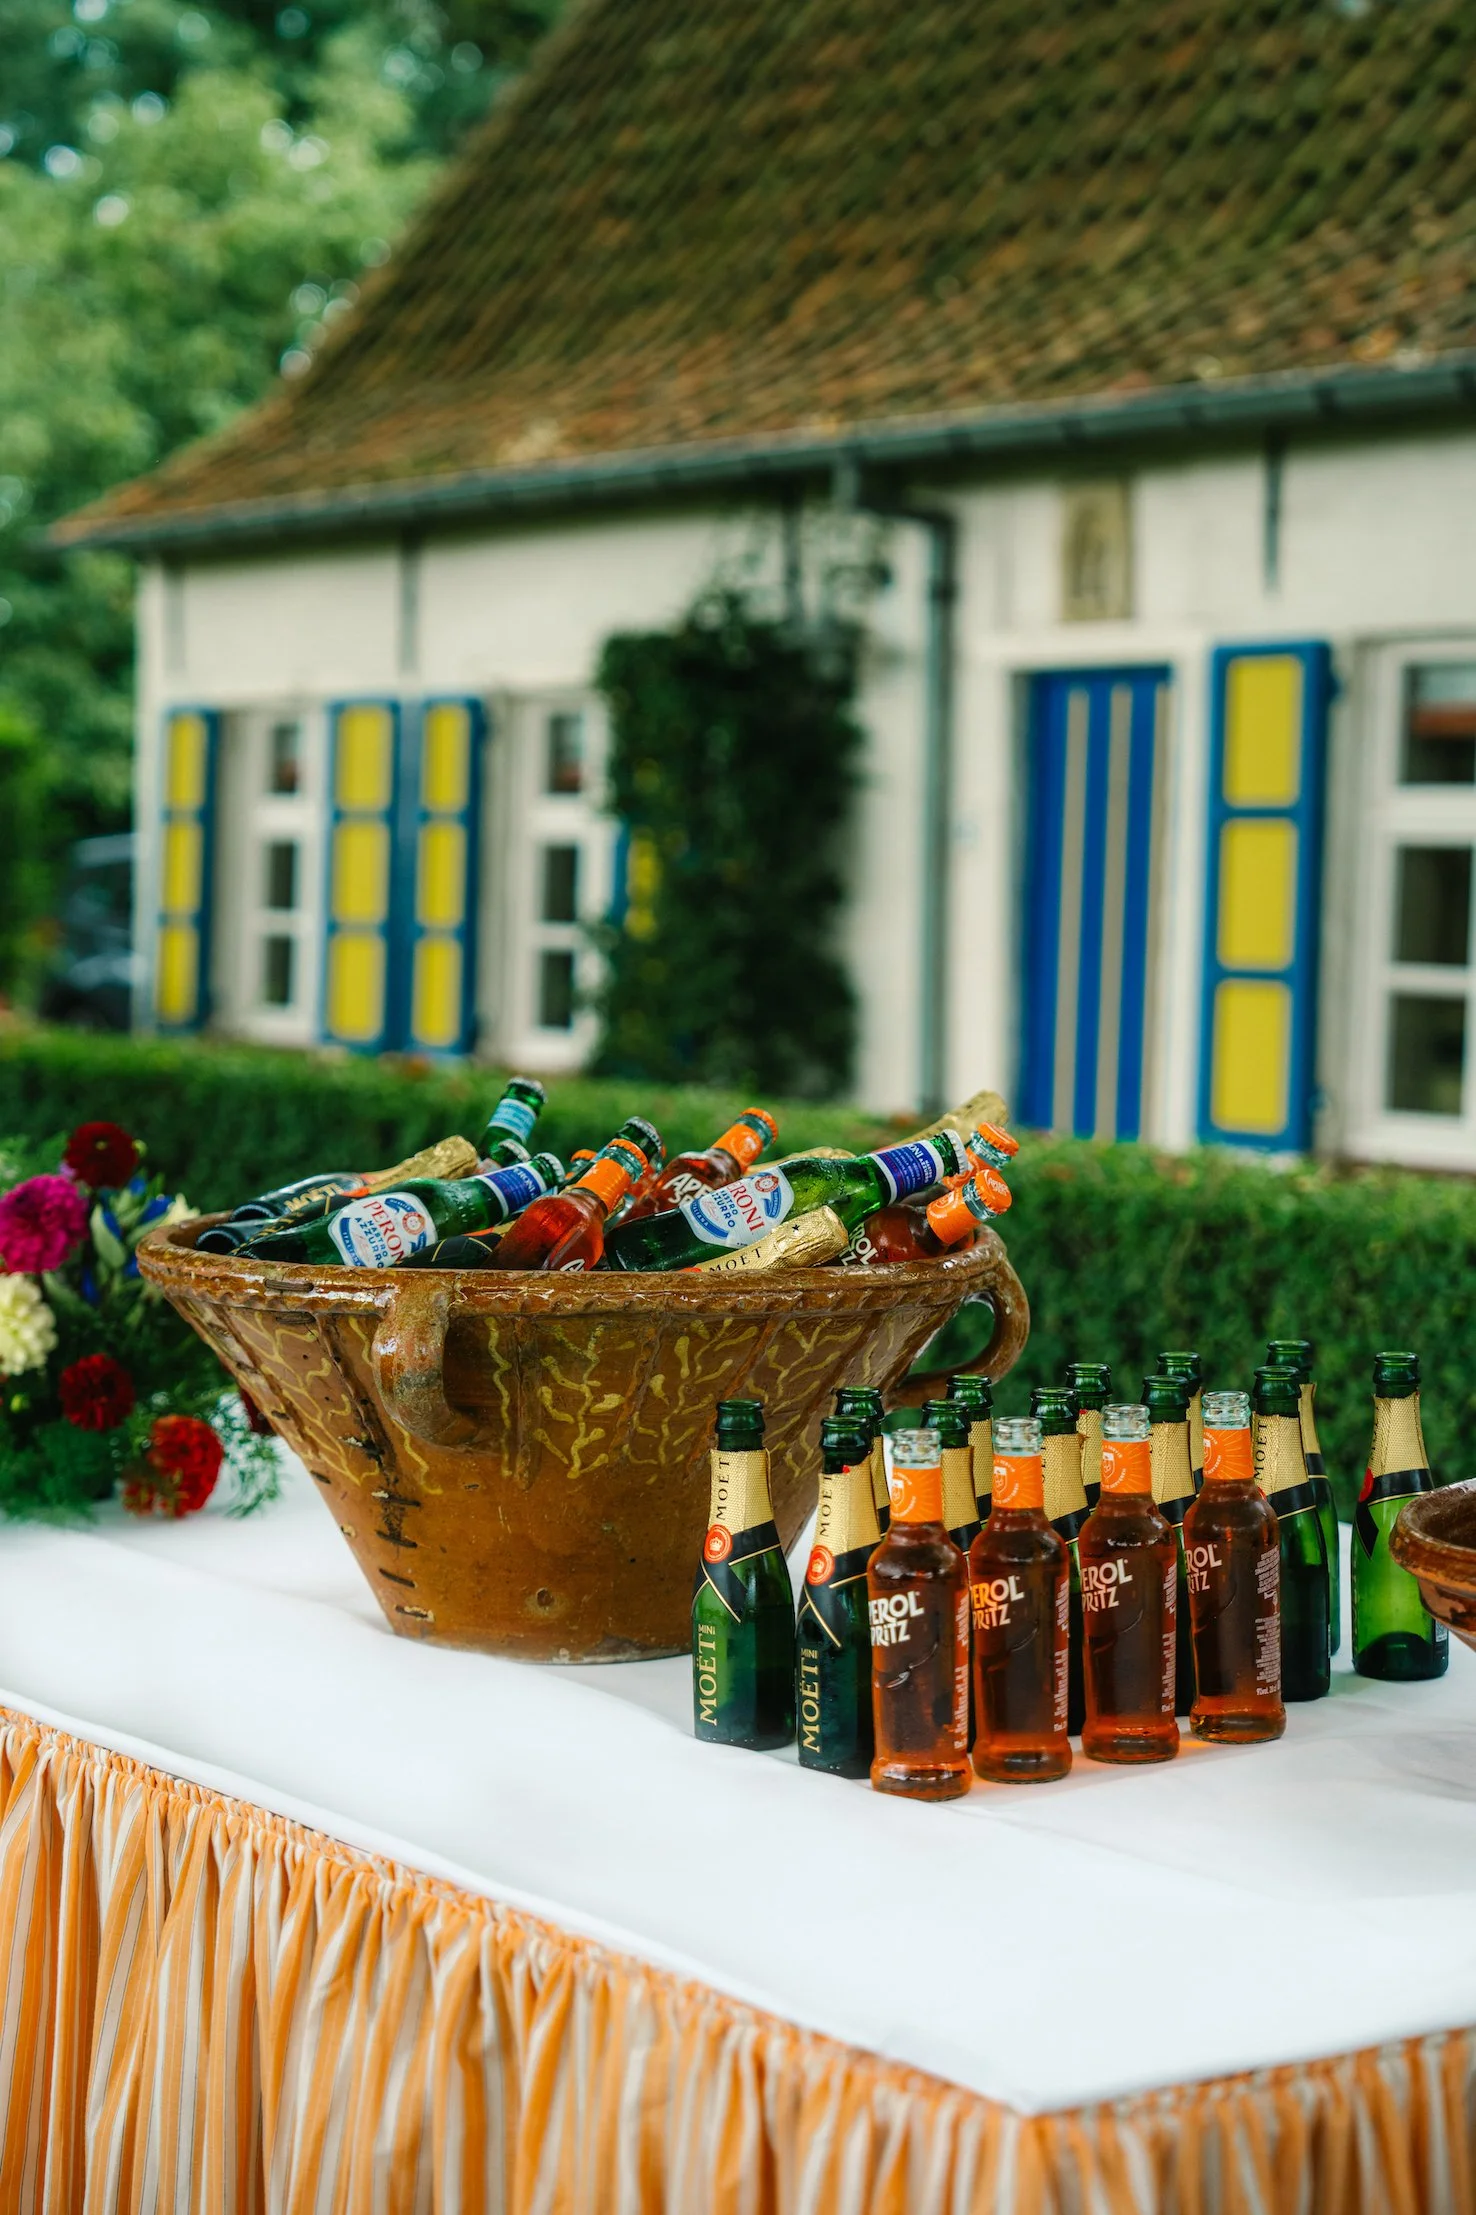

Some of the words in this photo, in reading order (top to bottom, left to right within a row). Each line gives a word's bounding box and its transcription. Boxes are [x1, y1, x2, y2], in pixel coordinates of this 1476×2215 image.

[662, 1173, 714, 1201] APE
[727, 1181, 766, 1232] ERONI
[363, 1201, 406, 1264] PERON
[698, 1624, 716, 1635] MINI
[801, 1647, 818, 1659] MINI
[697, 1633, 717, 1726] MOËT
[800, 1657, 821, 1754] MOËT
